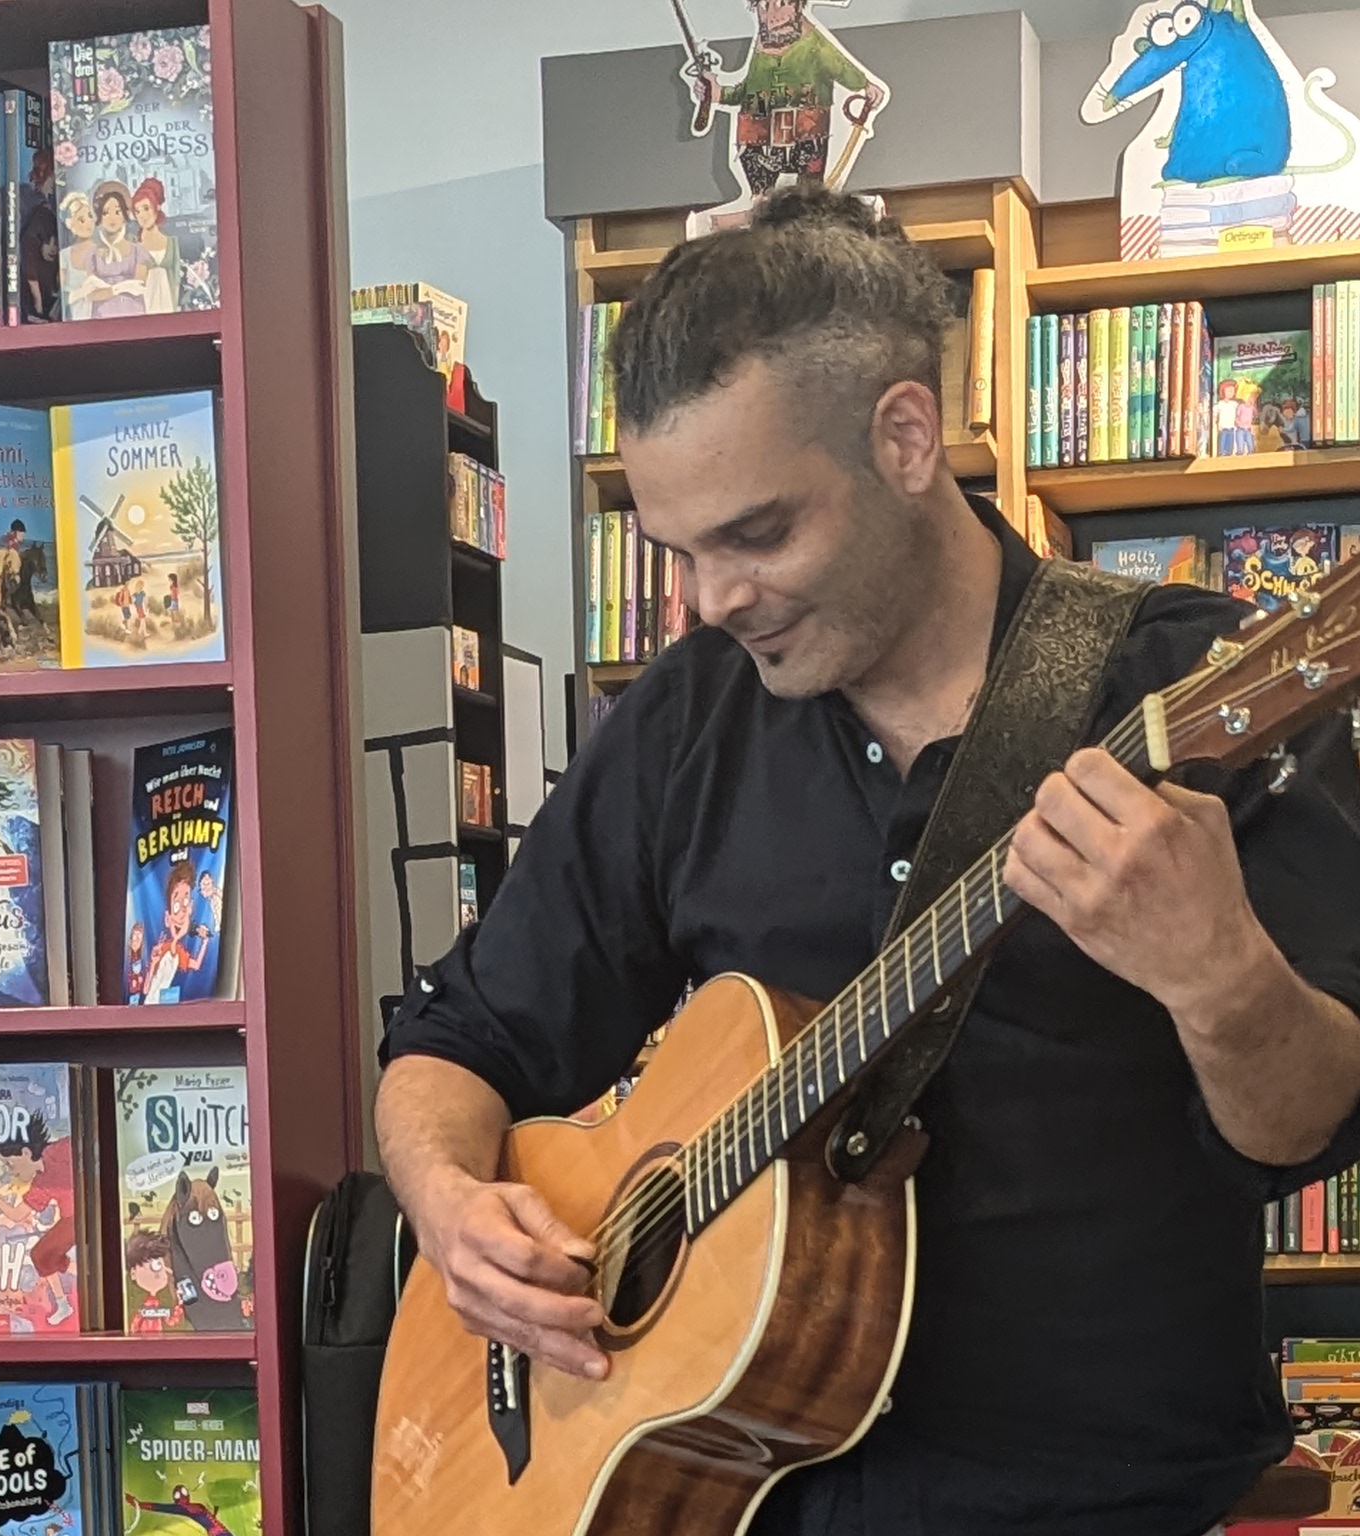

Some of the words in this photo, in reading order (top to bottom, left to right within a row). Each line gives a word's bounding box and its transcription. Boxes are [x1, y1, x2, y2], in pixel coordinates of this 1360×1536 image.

[134, 102, 160, 114] DER
[96, 114, 158, 141] BALL
[165, 120, 196, 132] DER
[77, 133, 209, 164] BARONESS
[1225, 230, 1267, 244] Oetinger
[113, 423, 174, 442] LAKRITZ-
[105, 443, 182, 477] SOMMER
[151, 783, 205, 820] REICH
[203, 798, 220, 811] und
[138, 816, 224, 863] BERÜHMT
[14, 1443, 37, 1468] of
[140, 1439, 261, 1461] SPIDER-MAN
